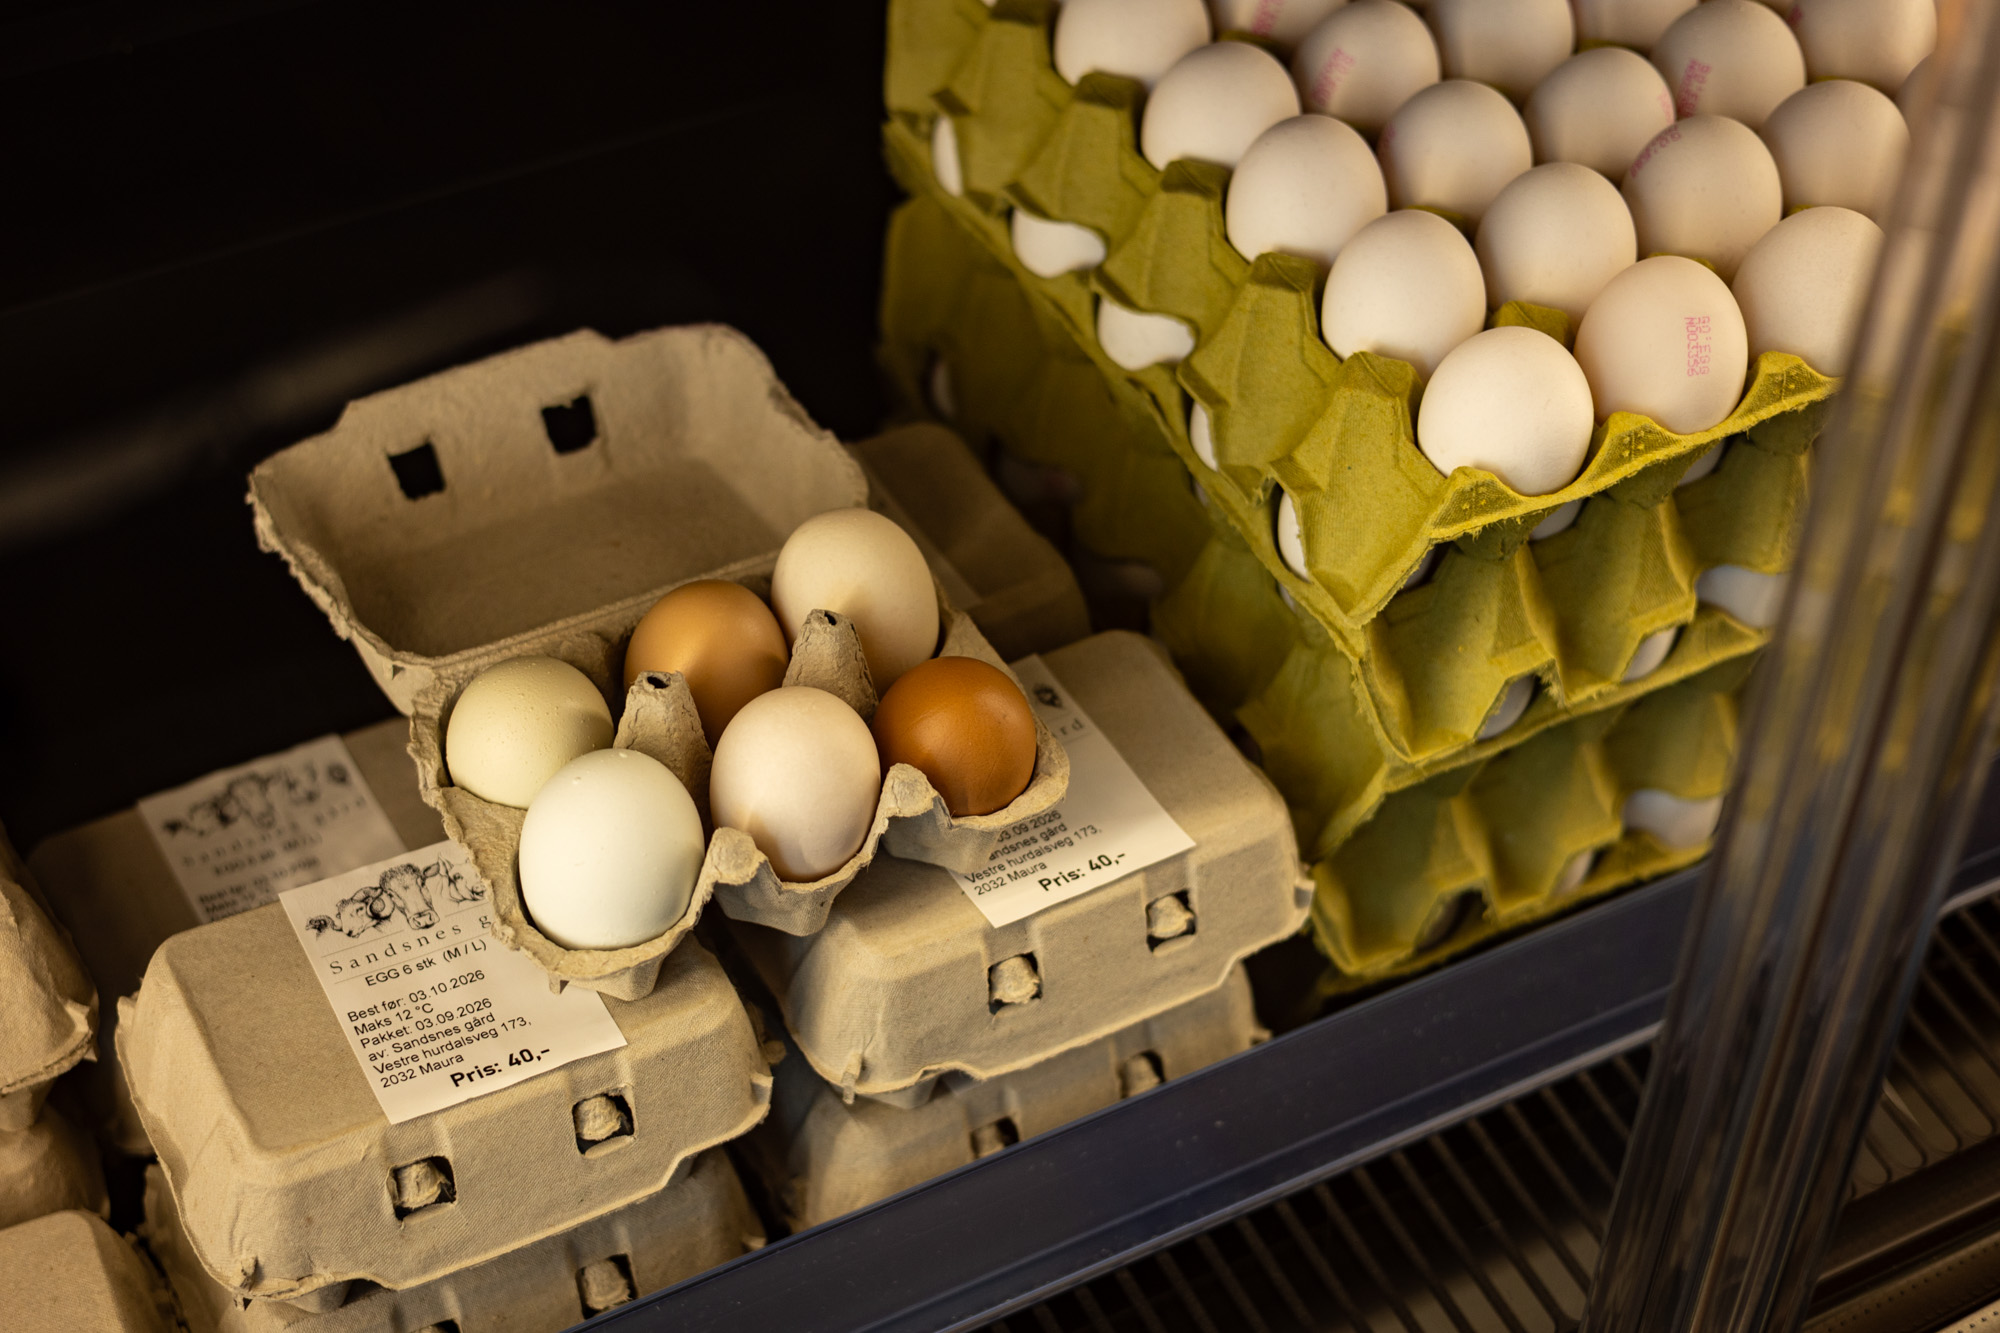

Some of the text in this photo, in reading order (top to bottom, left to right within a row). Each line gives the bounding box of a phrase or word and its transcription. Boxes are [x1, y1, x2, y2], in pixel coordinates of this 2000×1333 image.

[964, 863, 1006, 884] Vestre
[1006, 836, 1074, 868] hurdalsveg
[989, 822, 1067, 861] andsnes gård
[974, 861, 1047, 896] 2032 Maura
[1038, 852, 1125, 891] Pris: 40,-
[329, 924, 462, 975] Sandsnes
[365, 968, 400, 987] EGG
[402, 964, 413, 975] 6
[416, 957, 437, 971] stk
[347, 969, 485, 1022] Best før: 03.10.2026
[353, 1017, 392, 1036] Maks
[395, 1009, 413, 1022] 12
[360, 998, 492, 1049] Pakket: 03.09.2026
[368, 1012, 496, 1062] av: Sandsnes gård
[373, 1016, 532, 1074] Vestre hurdalsveg 173,
[380, 1053, 464, 1088] 2032 Maura
[450, 1048, 550, 1088] Pris: 40,-
